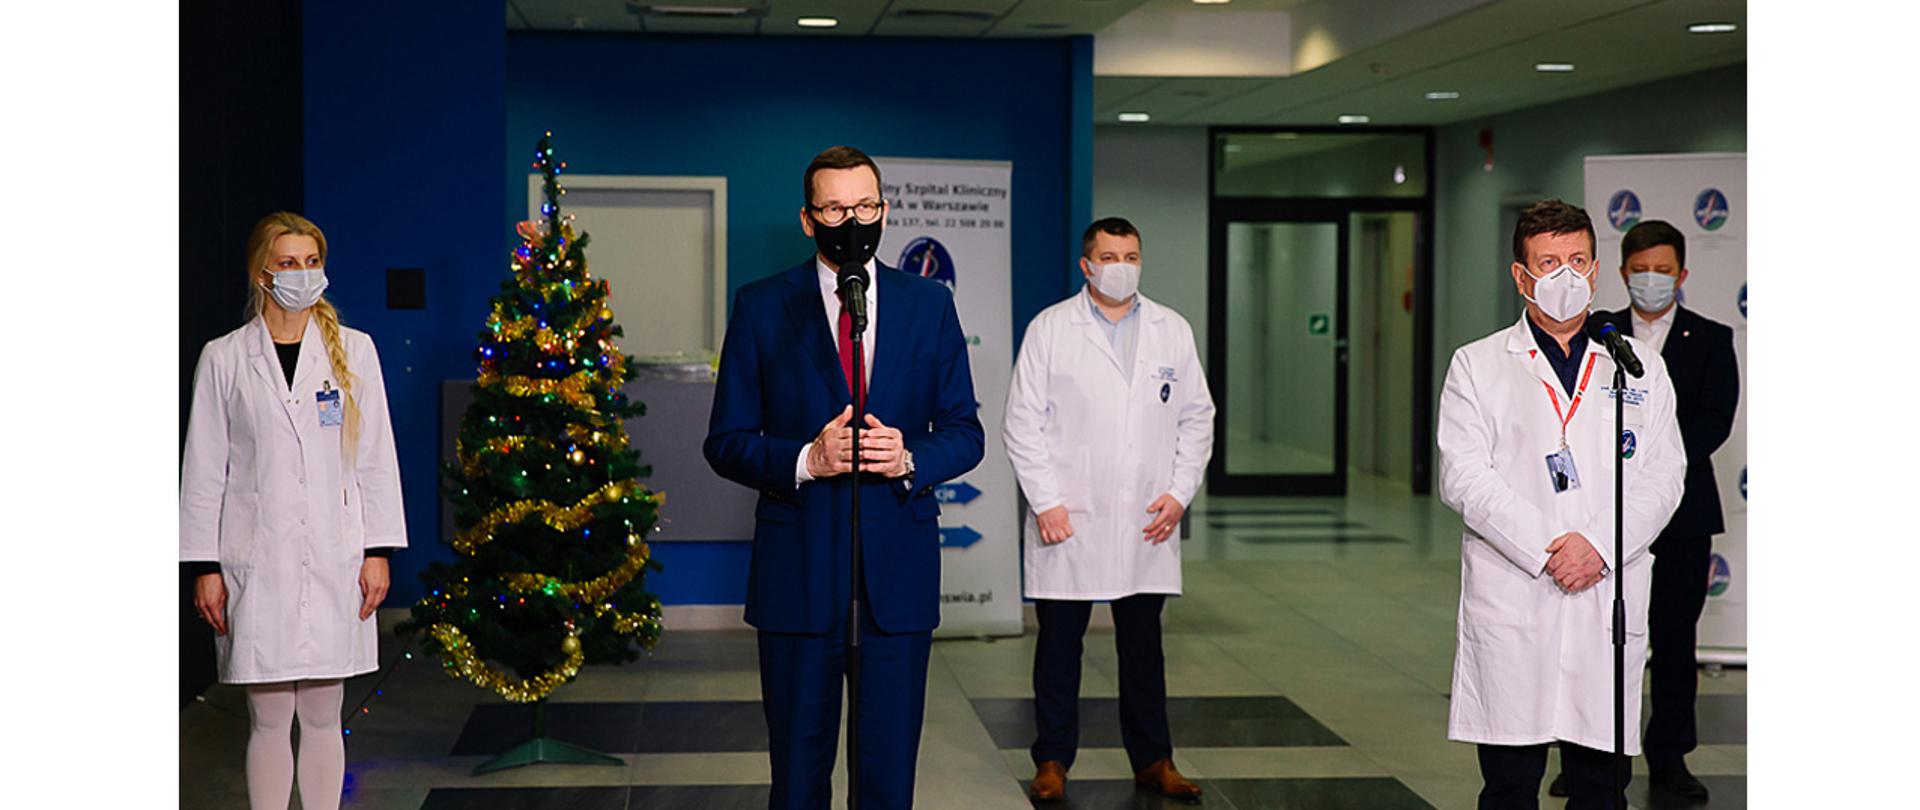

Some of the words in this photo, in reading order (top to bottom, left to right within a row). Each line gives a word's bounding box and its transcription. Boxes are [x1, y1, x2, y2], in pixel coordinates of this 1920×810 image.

[904, 182, 949, 196] Szpital
[953, 184, 1008, 199] Kliniczny
[908, 202, 918, 210] w
[922, 200, 990, 212] Warszawie
